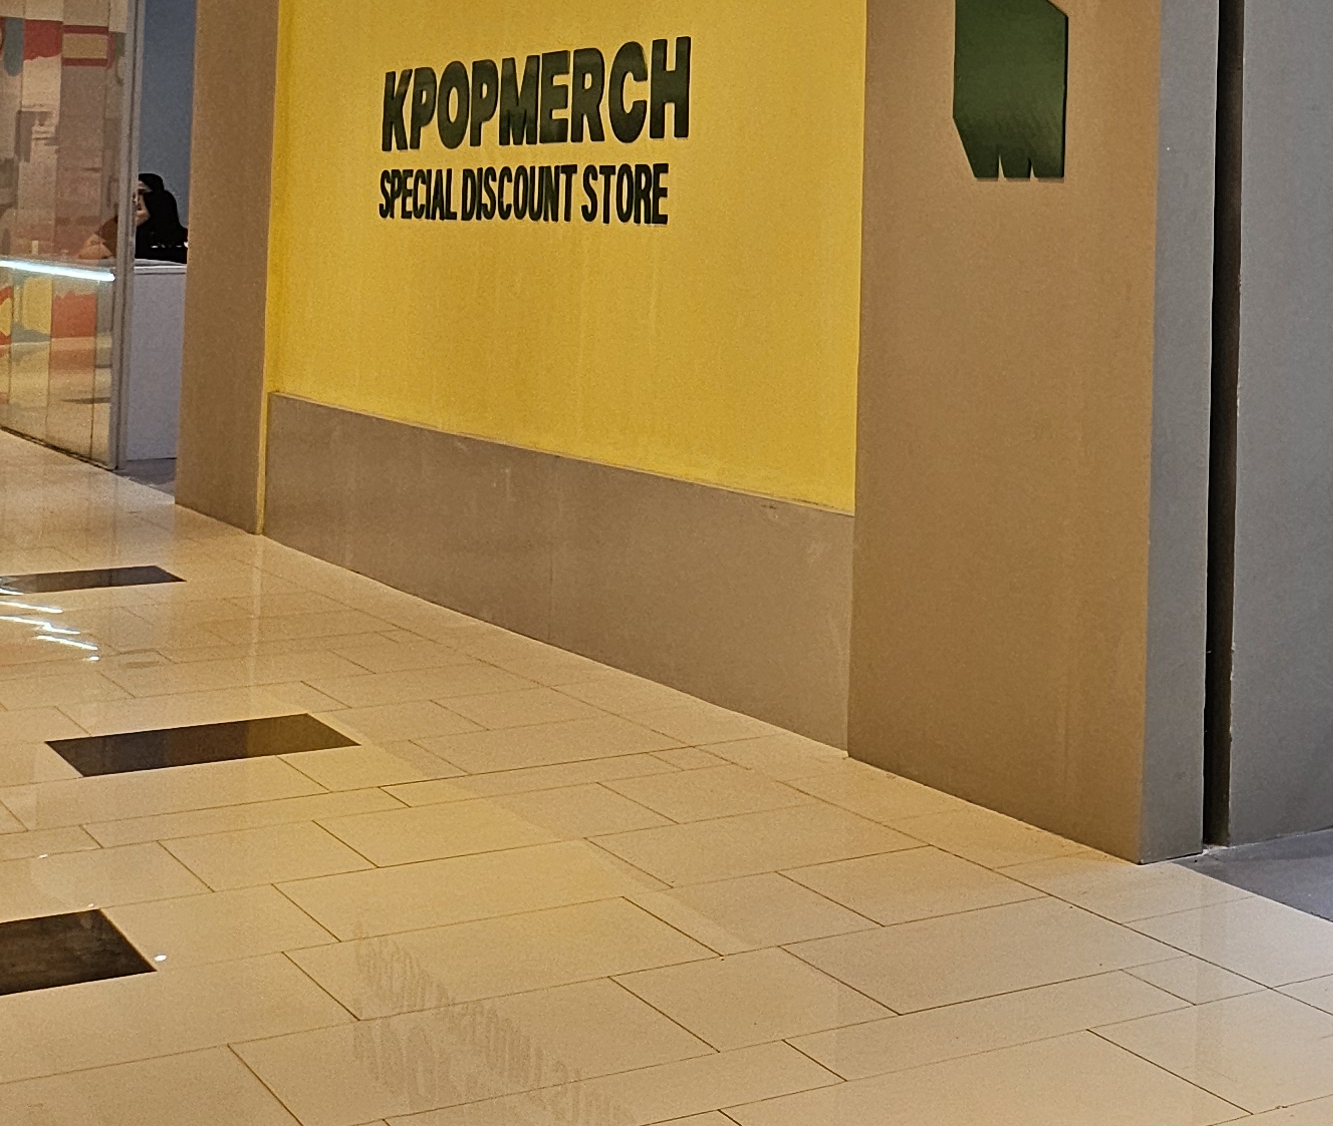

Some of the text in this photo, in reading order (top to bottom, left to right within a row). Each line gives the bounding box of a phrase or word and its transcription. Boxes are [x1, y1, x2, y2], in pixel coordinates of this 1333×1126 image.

[381, 36, 691, 151] KPOPMERCH
[379, 163, 669, 224] SPECIAL DISCOUNT STORE
